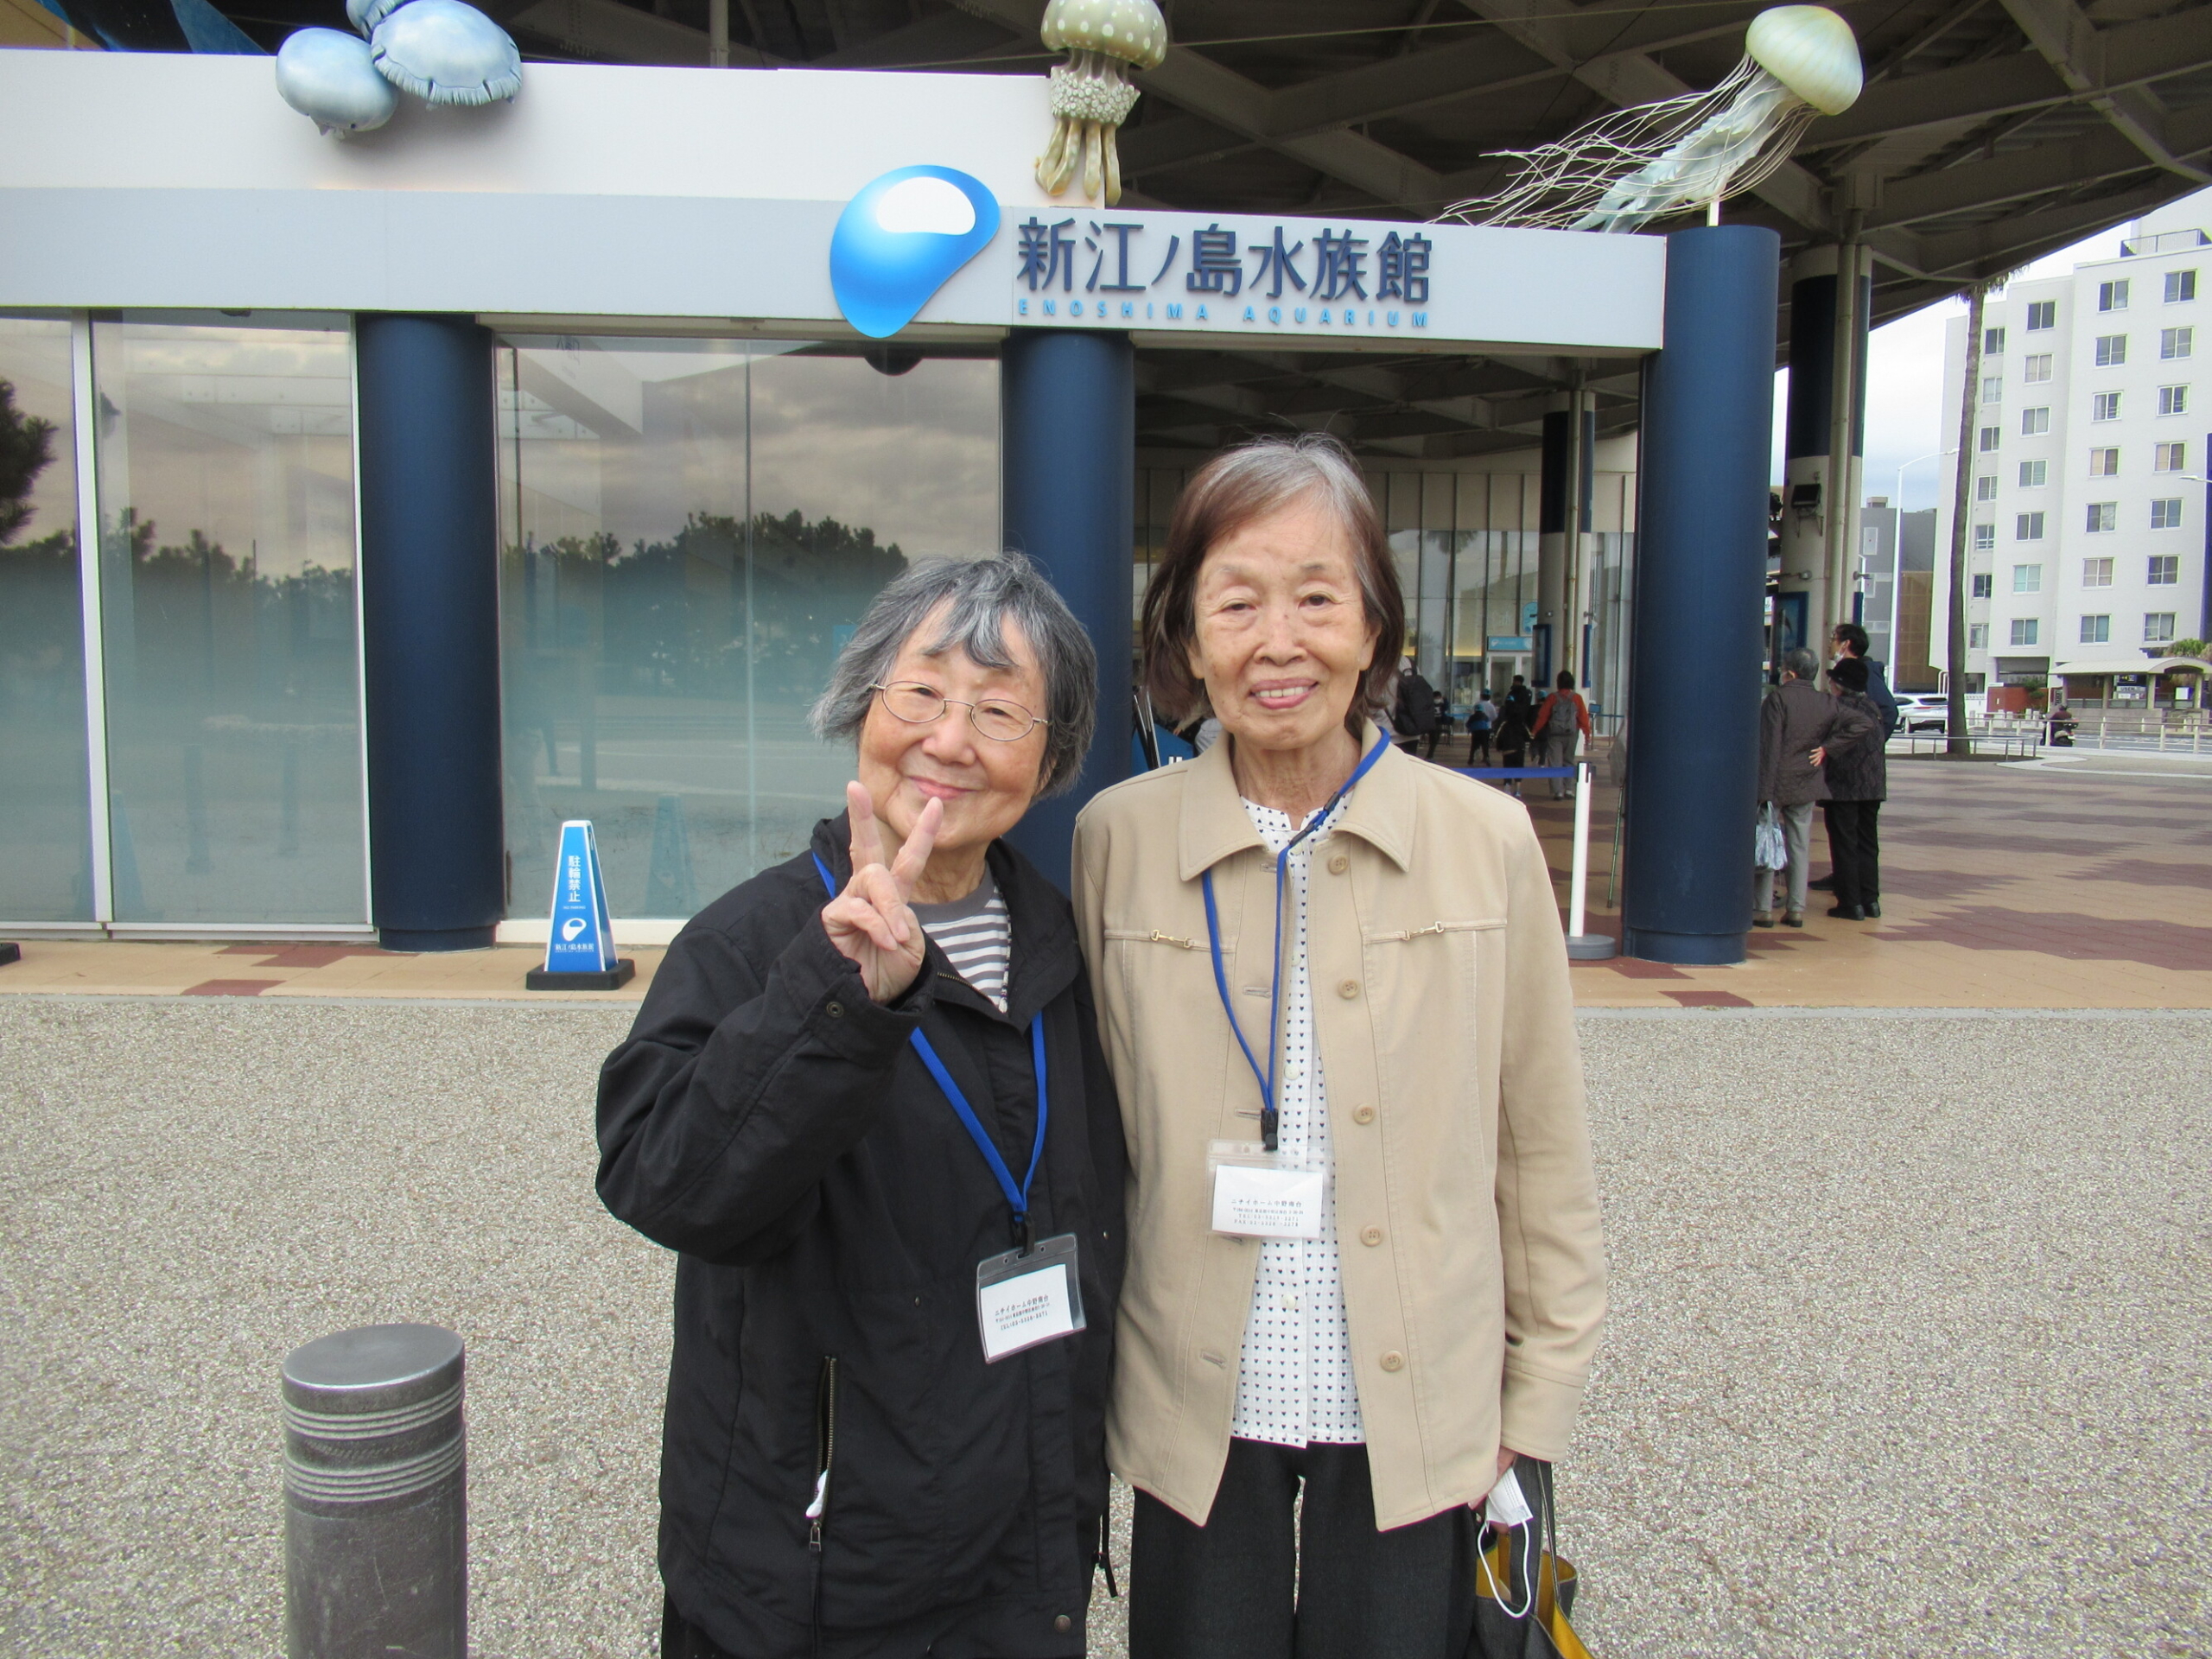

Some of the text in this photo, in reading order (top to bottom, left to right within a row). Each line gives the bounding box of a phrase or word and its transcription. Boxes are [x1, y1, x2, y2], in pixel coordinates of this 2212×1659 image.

[1016, 216, 1432, 302] 新江ノ島水族館
[1019, 298, 1428, 327] ENOSHIMA AQUARIUM
[569, 855, 581, 902] 駐輪禁止
